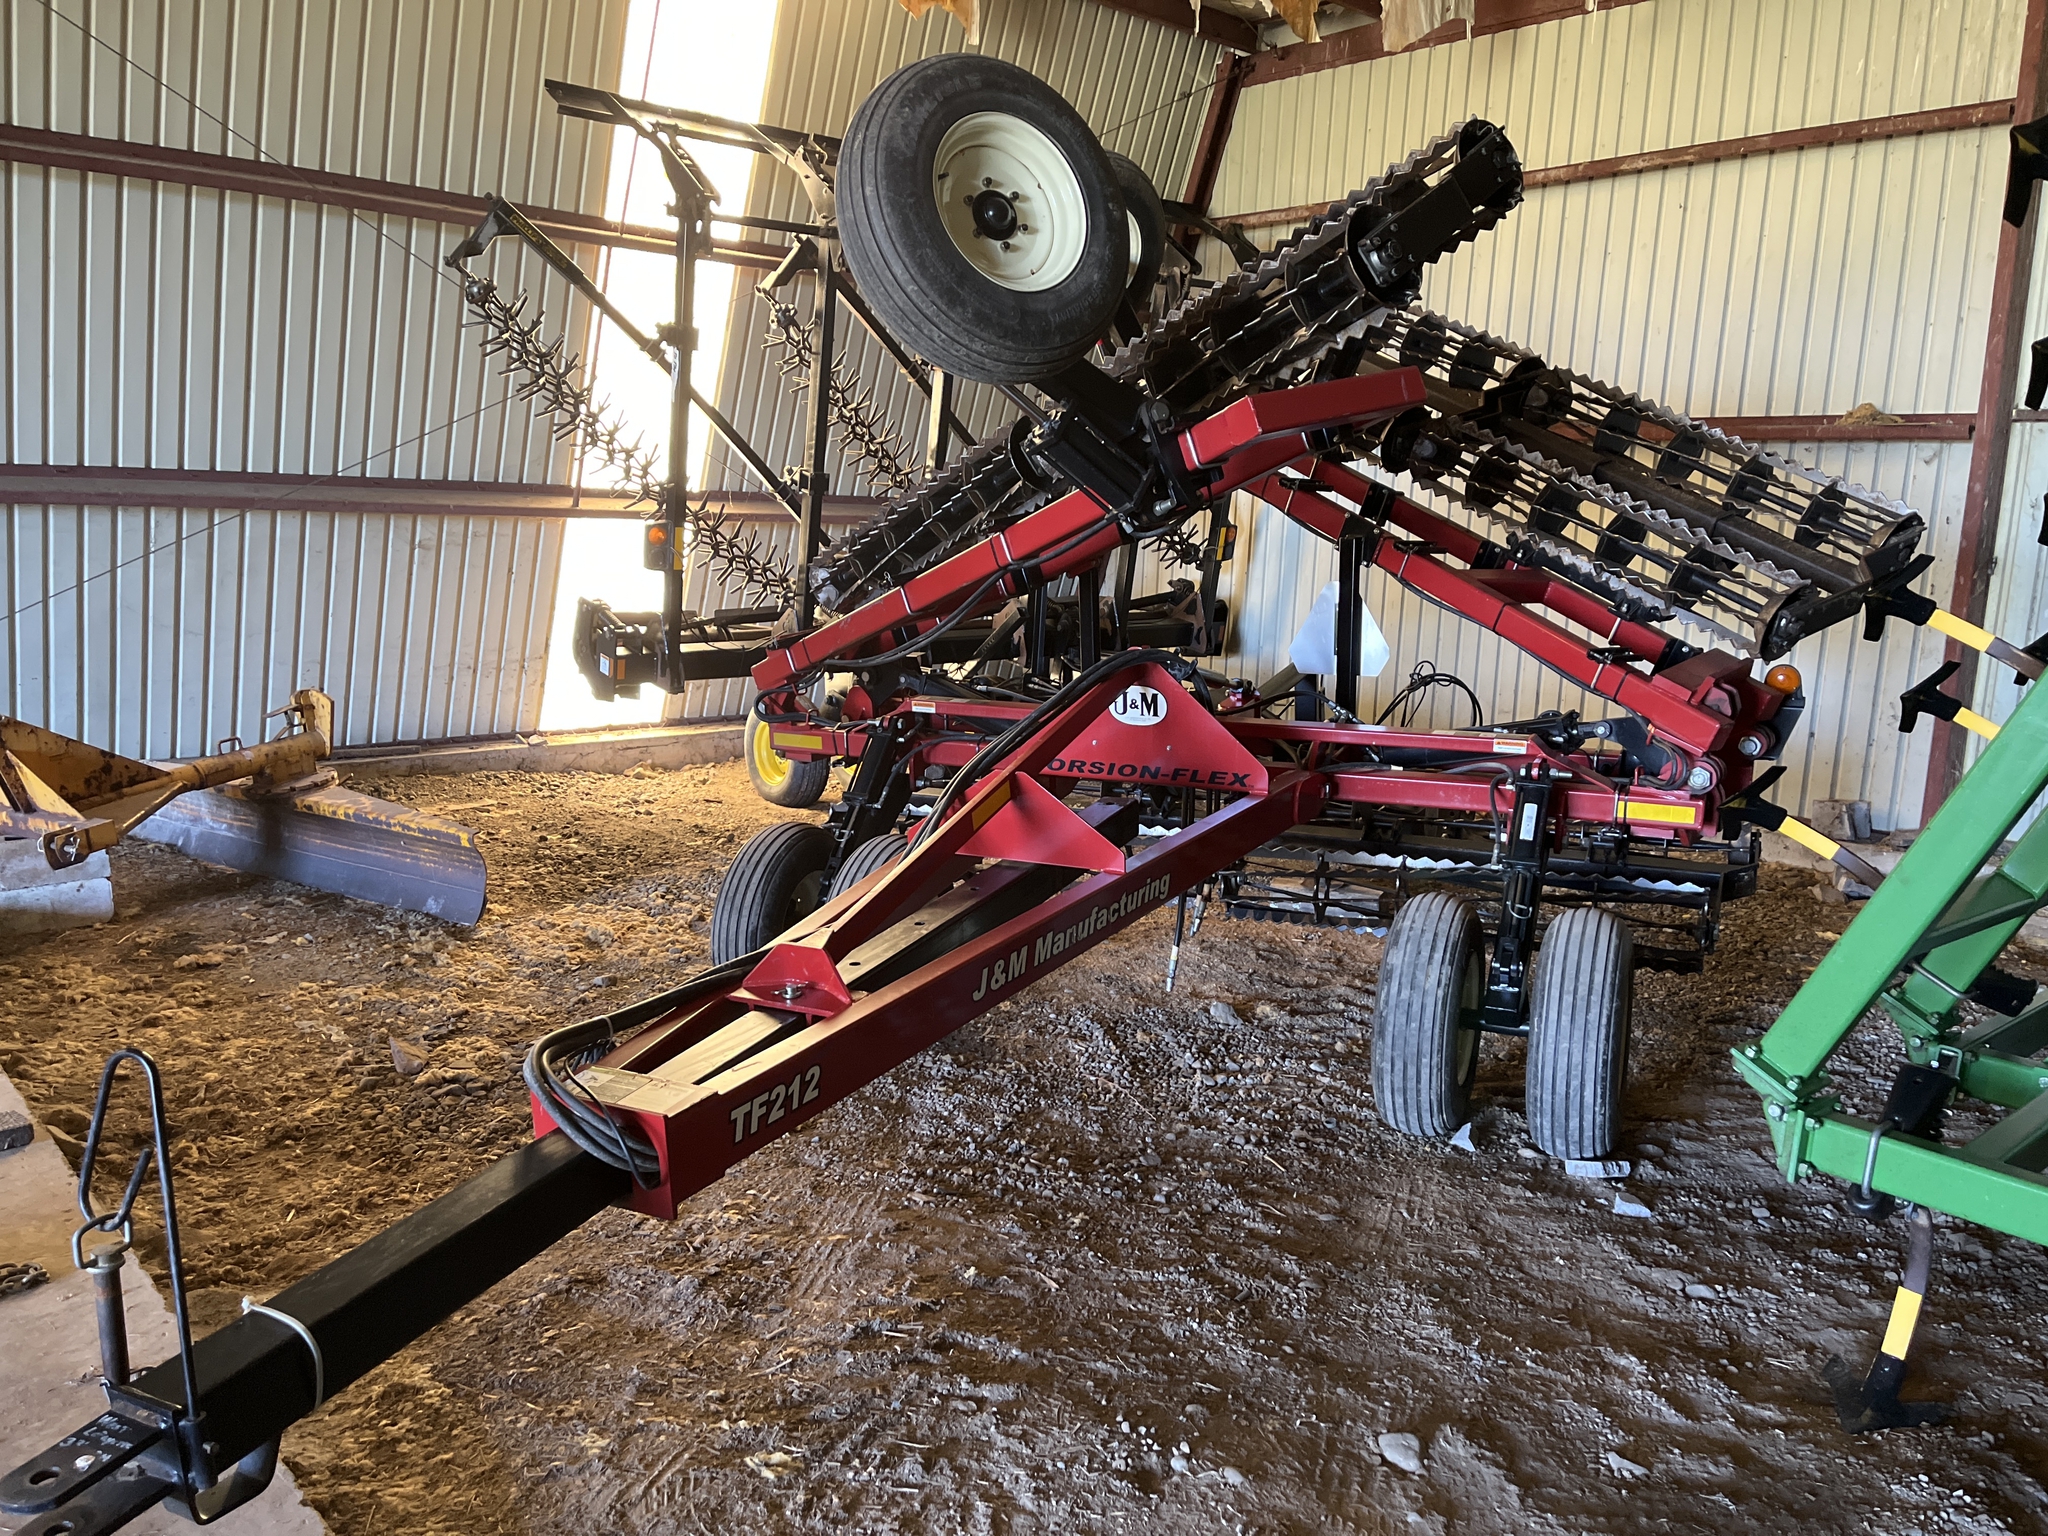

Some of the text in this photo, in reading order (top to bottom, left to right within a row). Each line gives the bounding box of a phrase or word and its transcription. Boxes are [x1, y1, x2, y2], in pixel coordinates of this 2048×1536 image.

[1114, 691, 1160, 717] J&M
[1046, 757, 1252, 788] ORSION-FLEX
[972, 873, 1171, 1002] J&M Manufacturing
[730, 1064, 821, 1144] TF212
